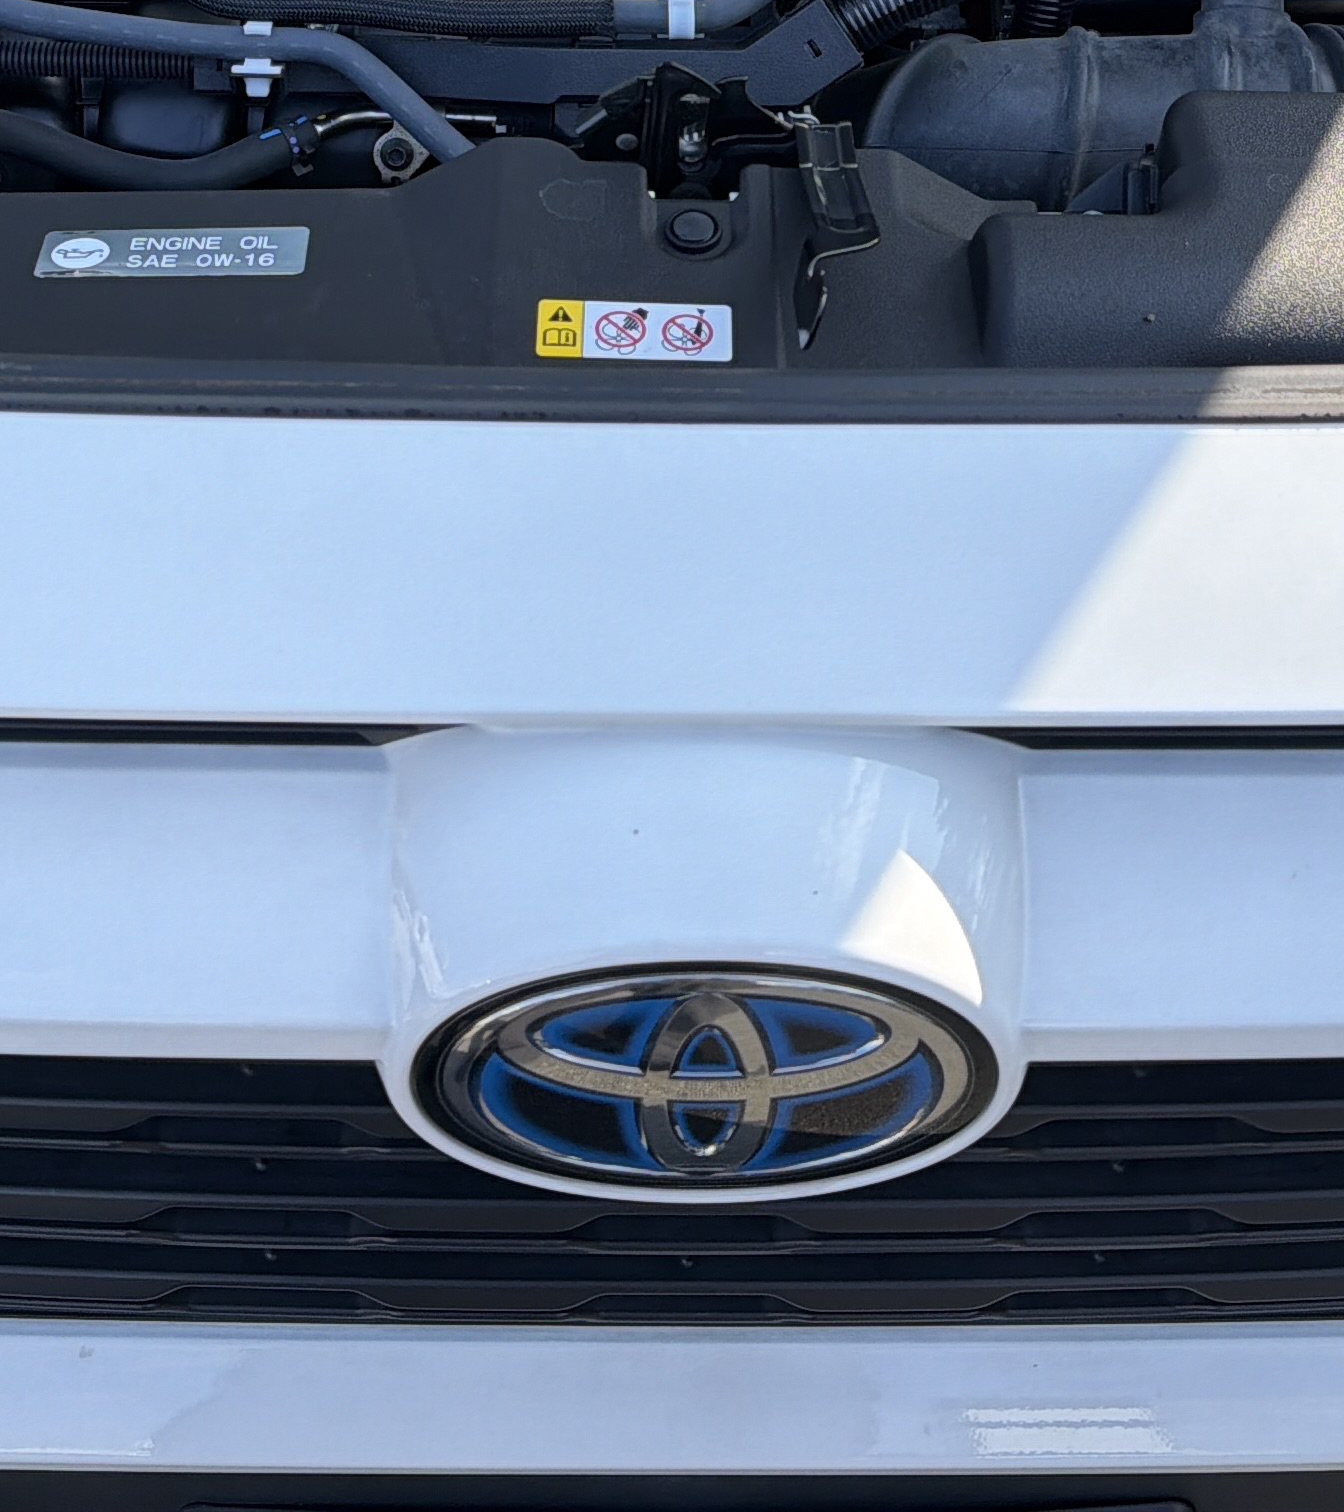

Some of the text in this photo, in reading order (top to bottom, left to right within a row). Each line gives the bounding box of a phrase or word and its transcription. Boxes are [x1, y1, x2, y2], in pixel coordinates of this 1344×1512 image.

[129, 235, 278, 251] ENGINE OIL
[125, 252, 275, 268] SAE 0W-16
